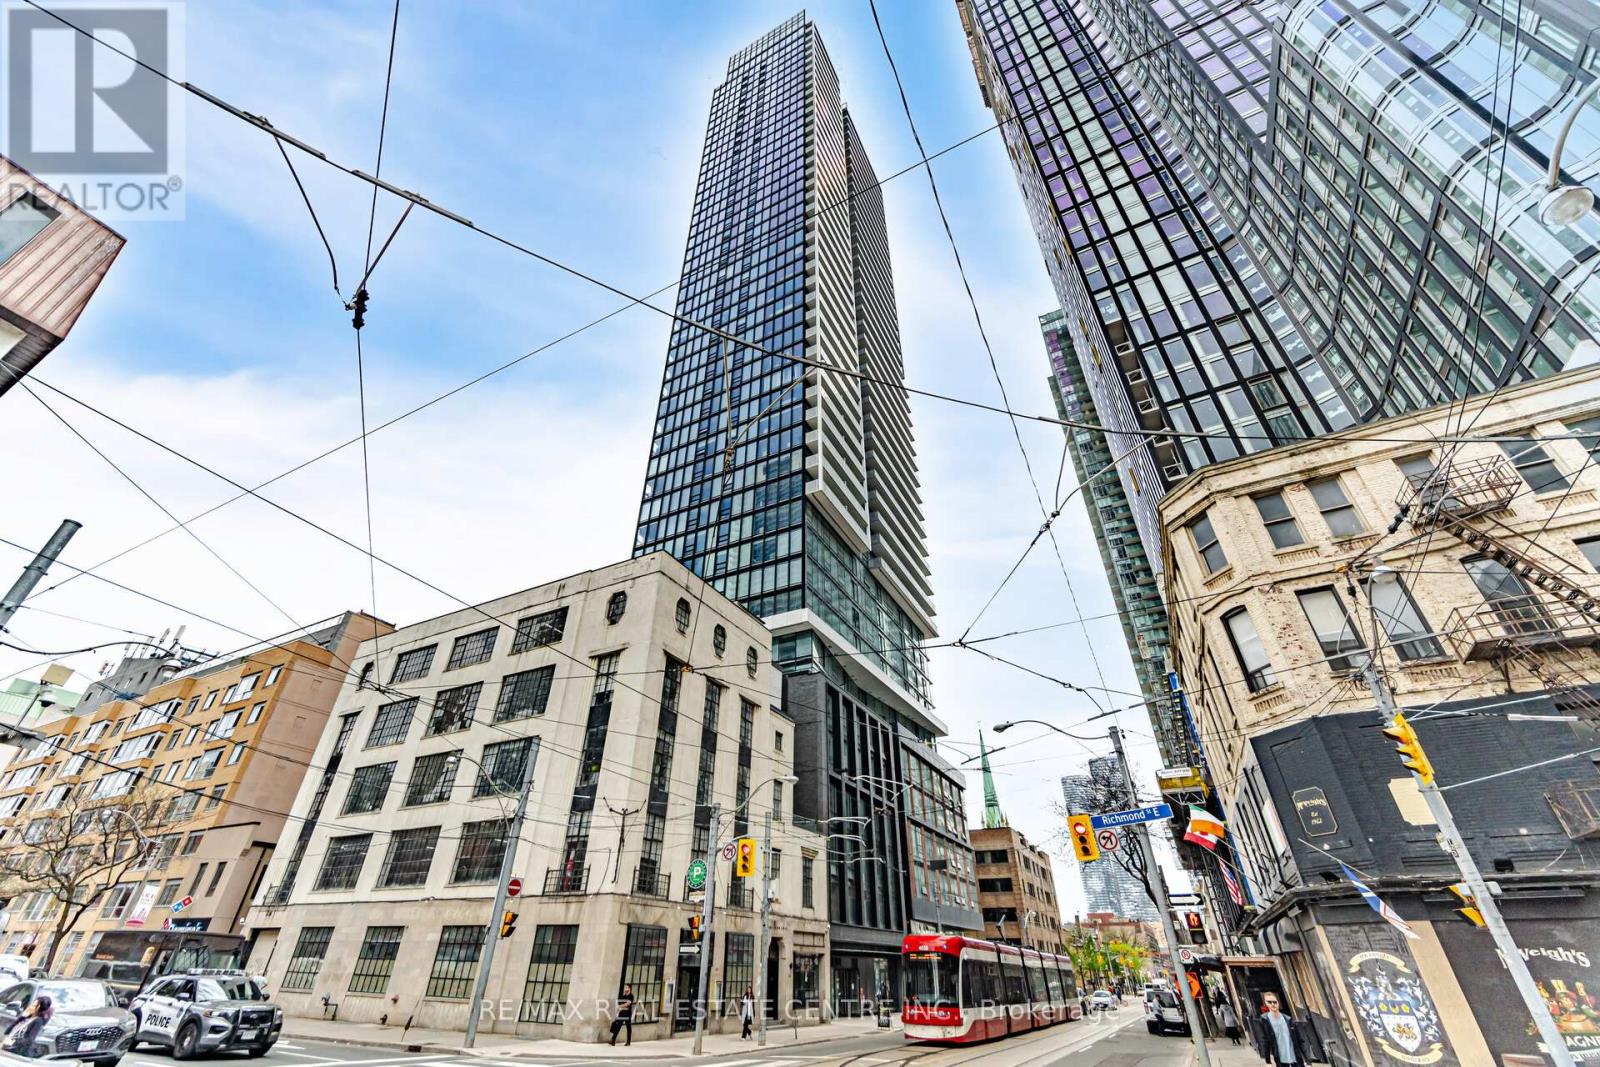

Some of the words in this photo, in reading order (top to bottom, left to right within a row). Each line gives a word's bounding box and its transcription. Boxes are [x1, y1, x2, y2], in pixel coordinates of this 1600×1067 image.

[1102, 810, 1146, 825] Richmond
[1153, 807, 1161, 817] E
[693, 866, 702, 878] P
[145, 1013, 172, 1028] POLICE
